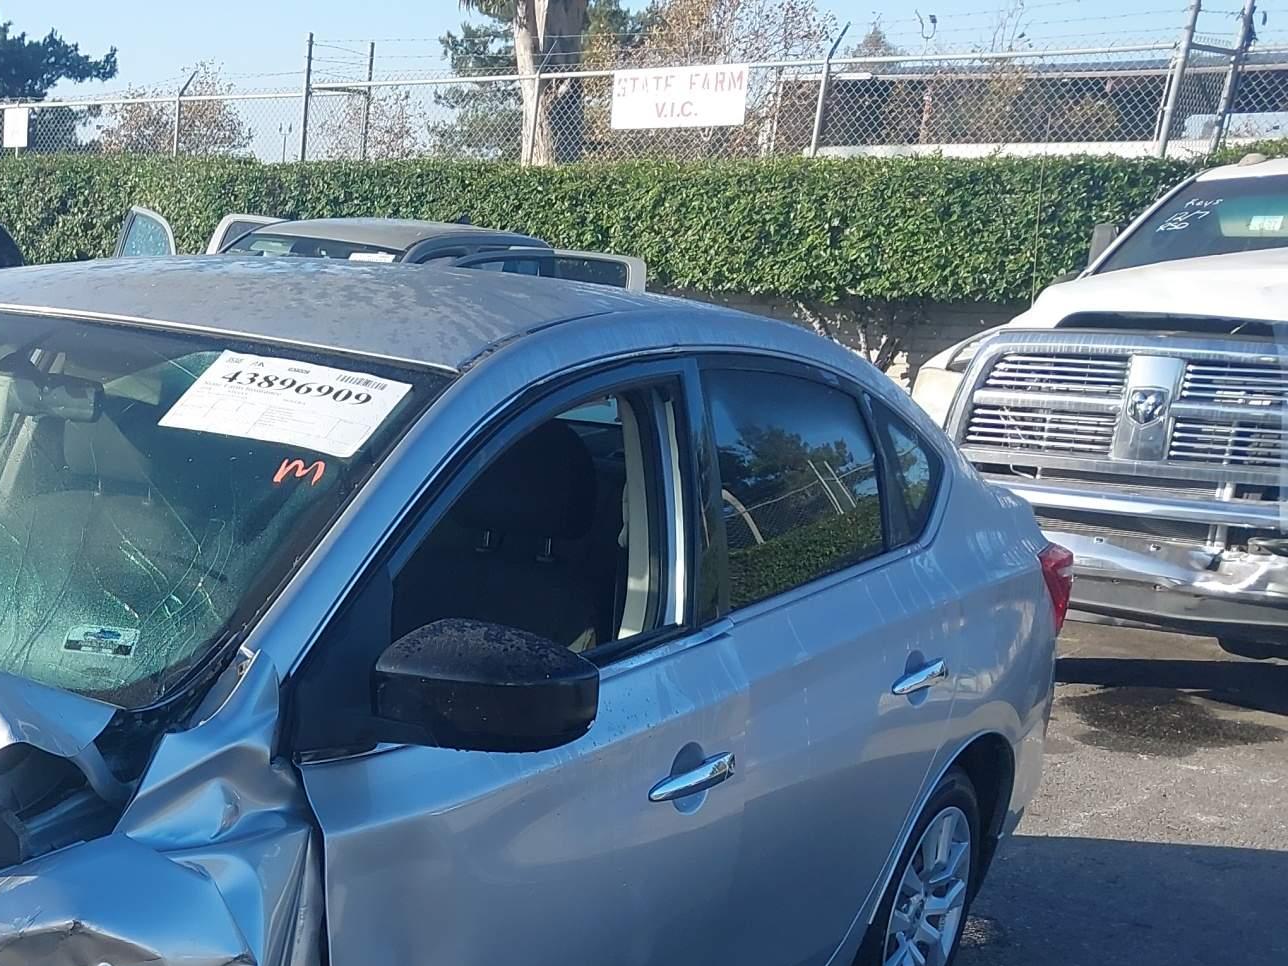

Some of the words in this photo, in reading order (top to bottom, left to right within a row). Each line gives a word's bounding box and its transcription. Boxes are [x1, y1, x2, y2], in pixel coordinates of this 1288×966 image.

[616, 74, 676, 97] STATE
[689, 70, 744, 93] FARM
[655, 100, 699, 118] V.I.C.
[220, 369, 373, 406] 43896909
